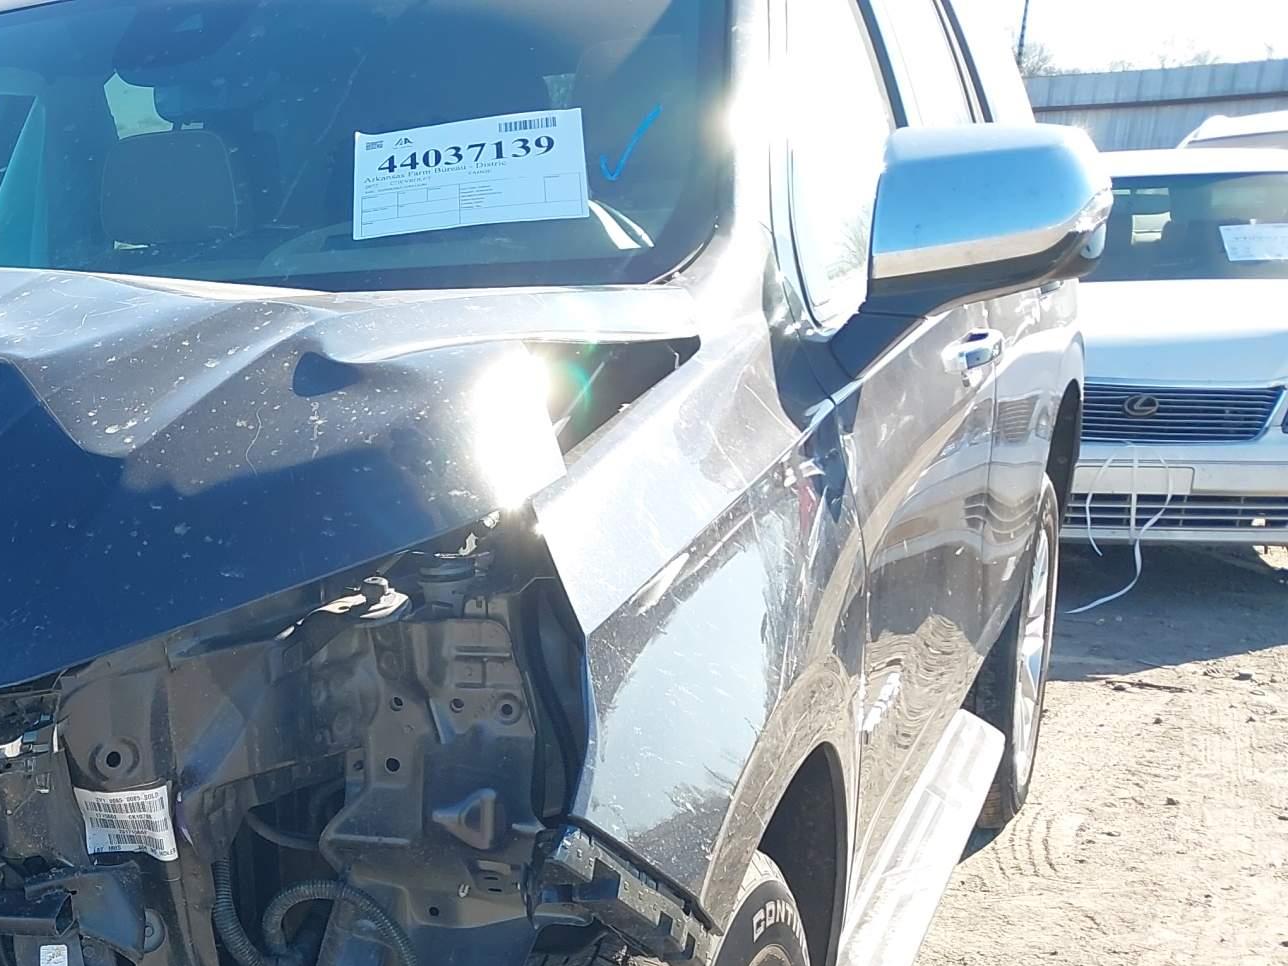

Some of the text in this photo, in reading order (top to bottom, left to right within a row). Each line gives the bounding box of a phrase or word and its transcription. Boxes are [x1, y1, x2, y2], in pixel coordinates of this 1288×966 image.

[377, 135, 555, 173] 44037139
[363, 172, 405, 184] Arkansas
[408, 168, 431, 177] Farm
[434, 164, 467, 173] Bureau
